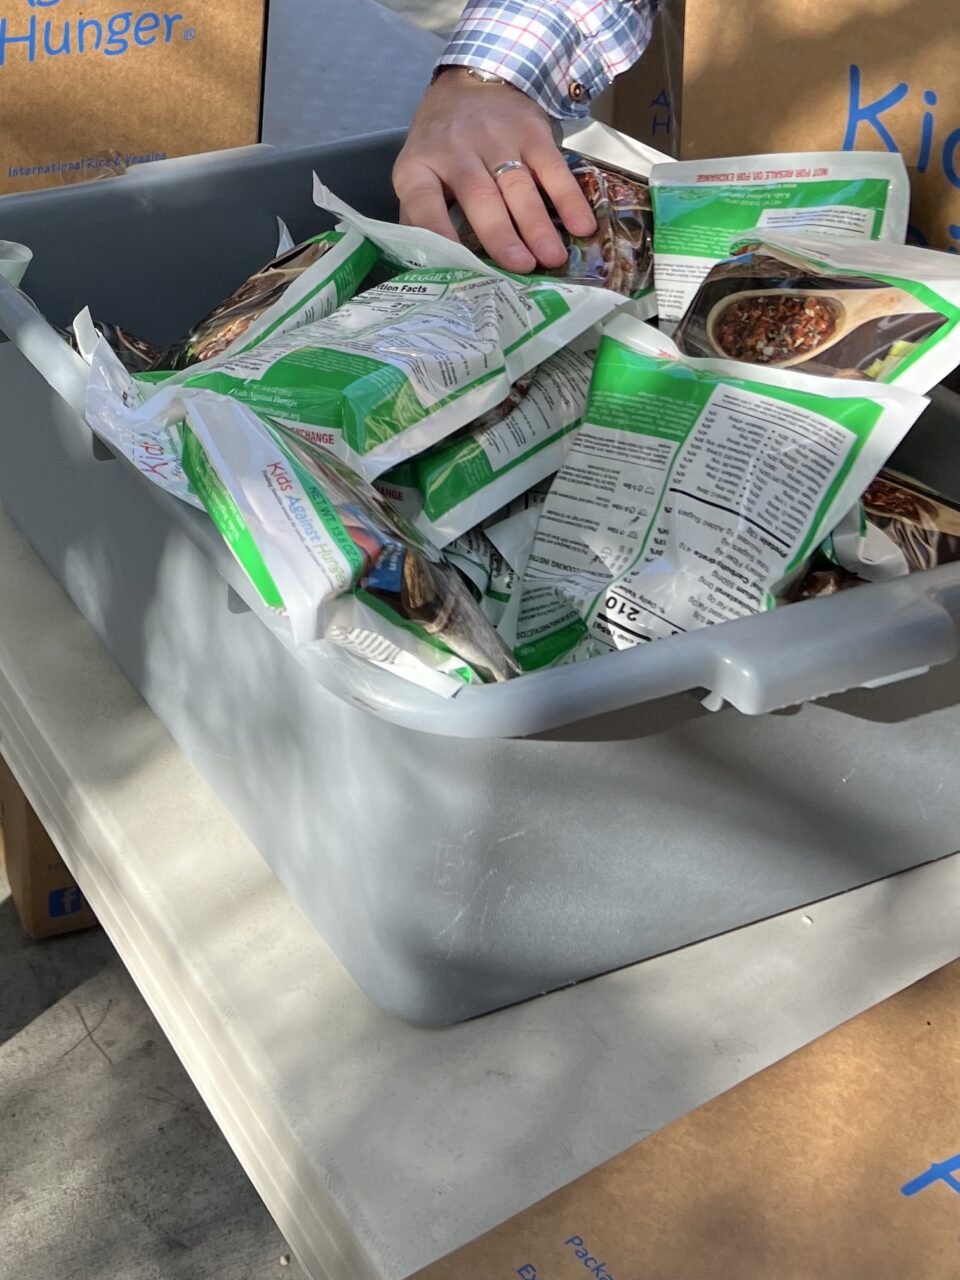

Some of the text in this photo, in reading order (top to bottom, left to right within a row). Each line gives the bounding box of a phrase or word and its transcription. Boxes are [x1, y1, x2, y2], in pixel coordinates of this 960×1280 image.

[695, 167, 829, 183] NOT FOR RESALE OR FOR EXCHANGE
[400, 284, 427, 294] Facts
[266, 459, 294, 493] Kids
[283, 489, 323, 544] Against
[701, 518, 724, 534] Added
[756, 536, 788, 558] Protein
[691, 549, 750, 584] Carbohydrate
[603, 594, 640, 622] 210
